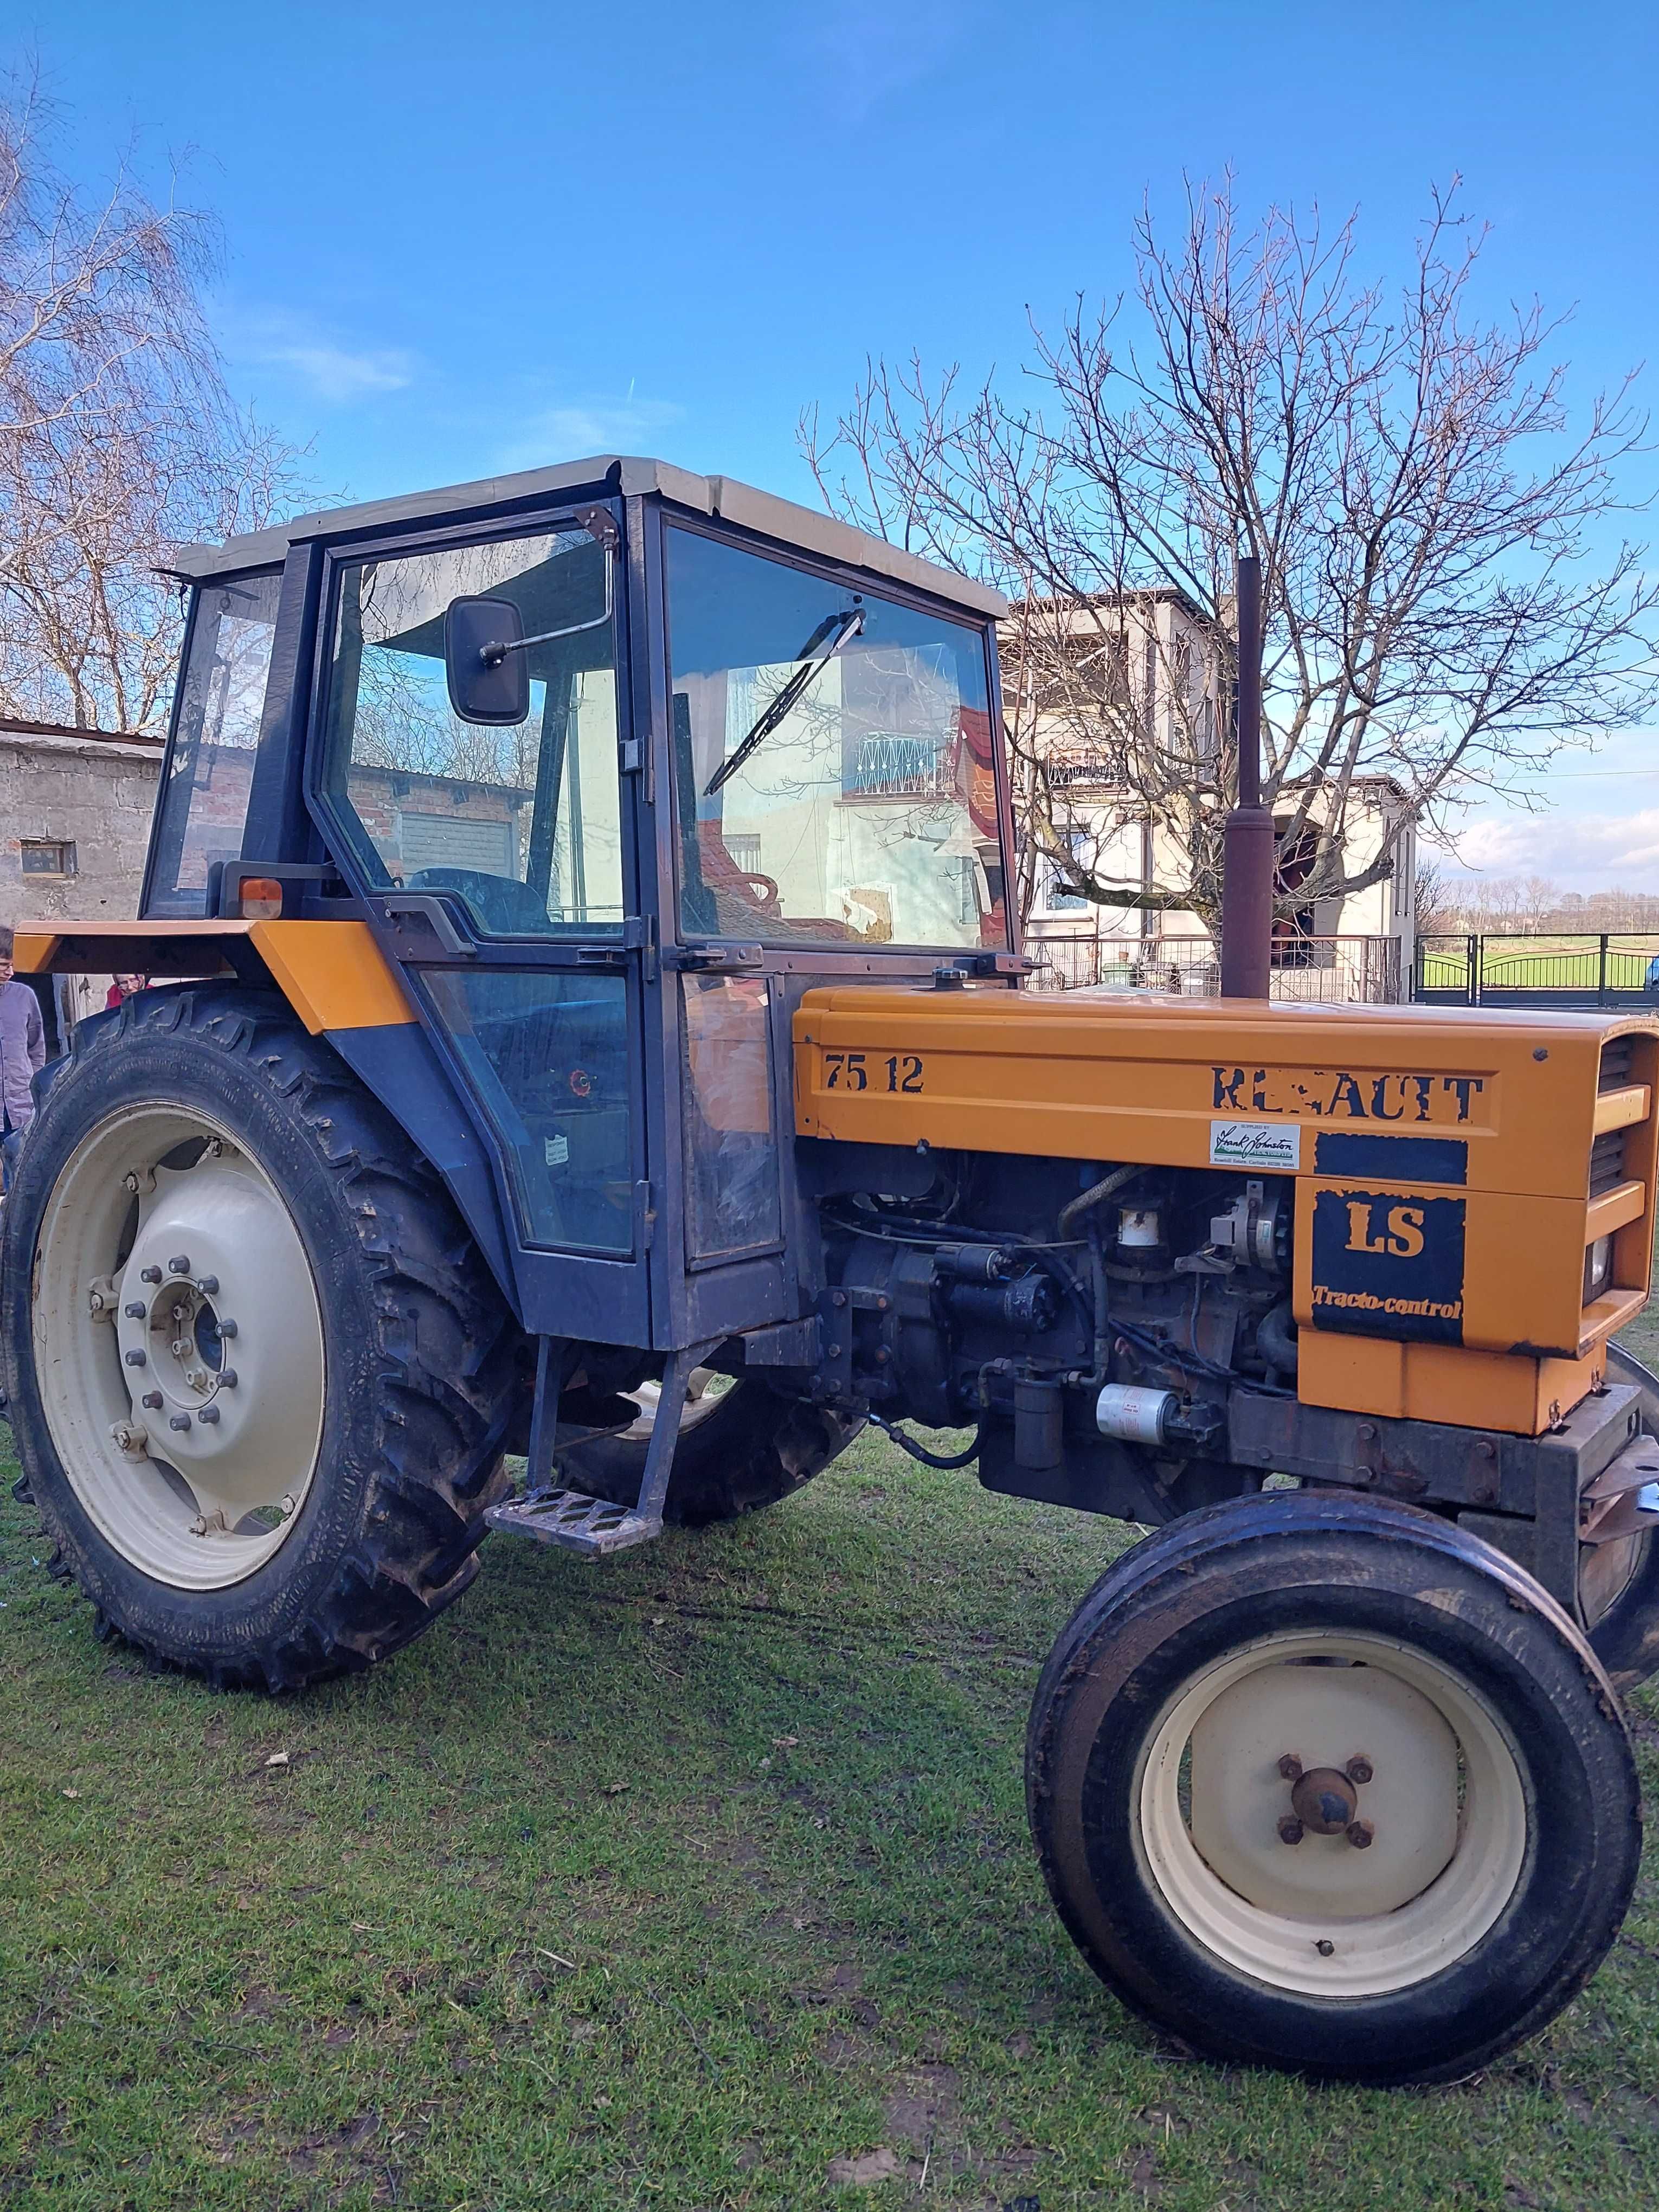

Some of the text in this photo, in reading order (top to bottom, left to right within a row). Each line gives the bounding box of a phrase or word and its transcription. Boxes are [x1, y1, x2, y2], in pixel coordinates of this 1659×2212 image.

[1216, 1126, 1294, 1159] Frank Johnston
[1345, 1201, 1424, 1257] LS
[1313, 1285, 1462, 1320] Tracto-control
